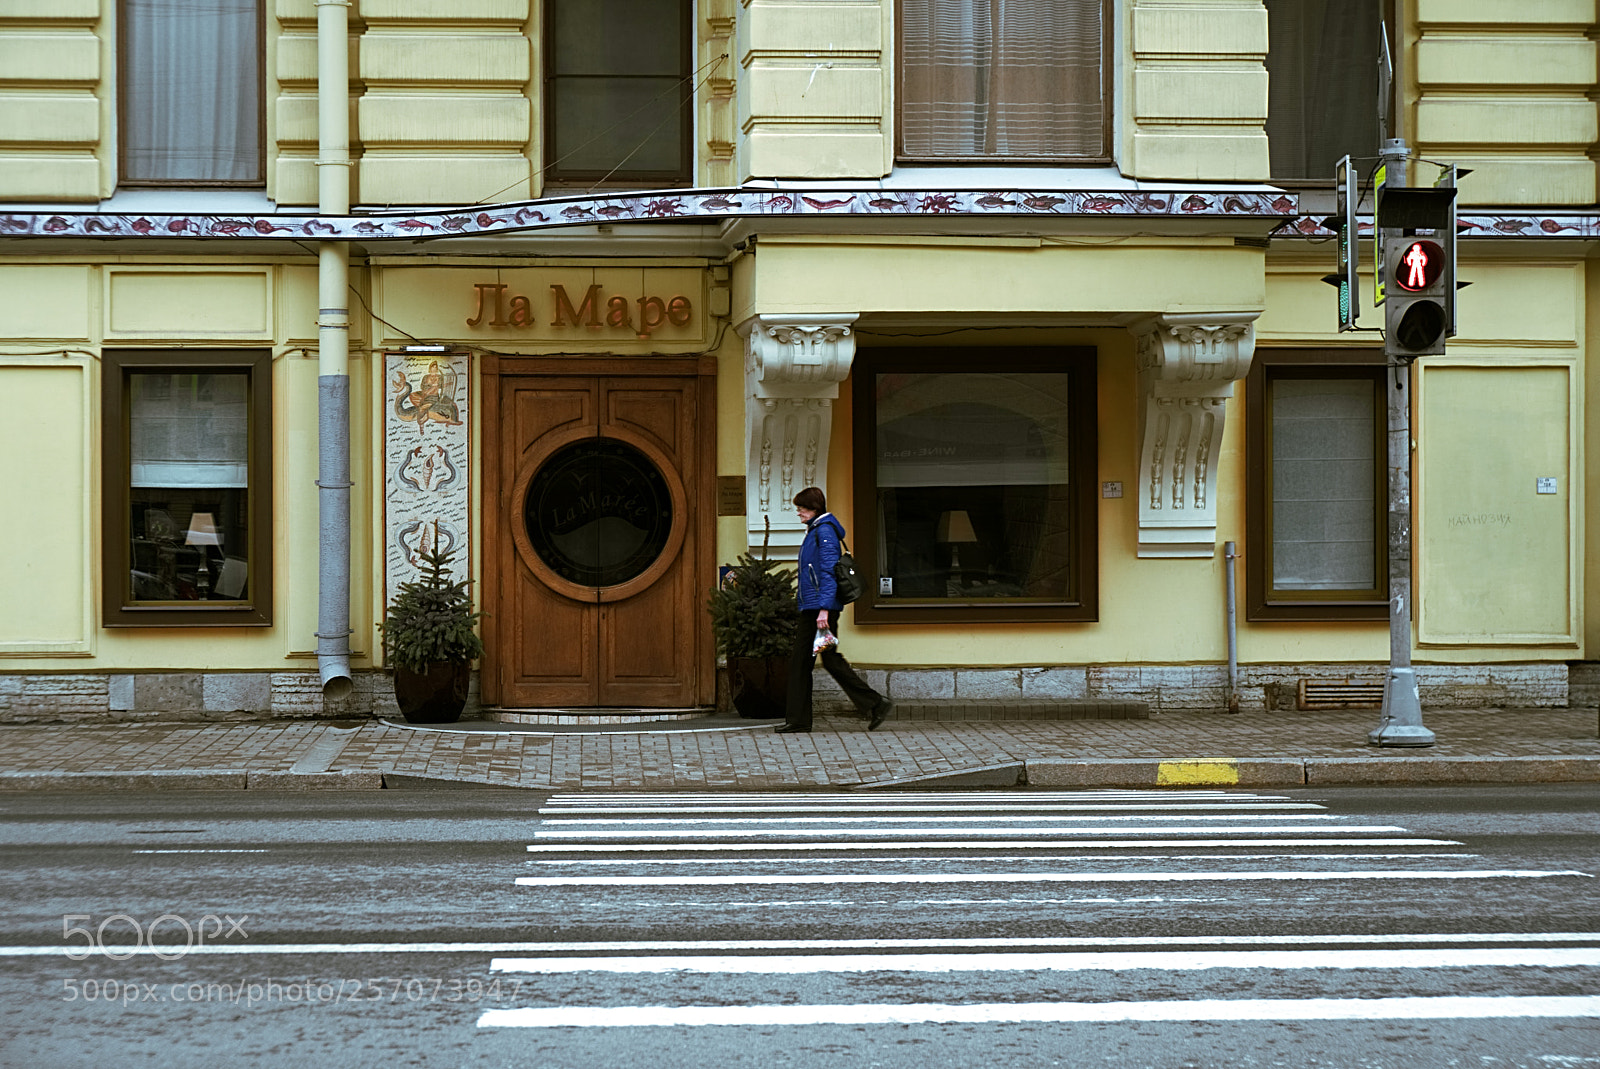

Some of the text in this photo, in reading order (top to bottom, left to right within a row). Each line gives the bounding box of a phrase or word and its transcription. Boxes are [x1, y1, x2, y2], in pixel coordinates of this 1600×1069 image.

[466, 283, 692, 336] Ла Маре
[552, 506, 577, 528] La
